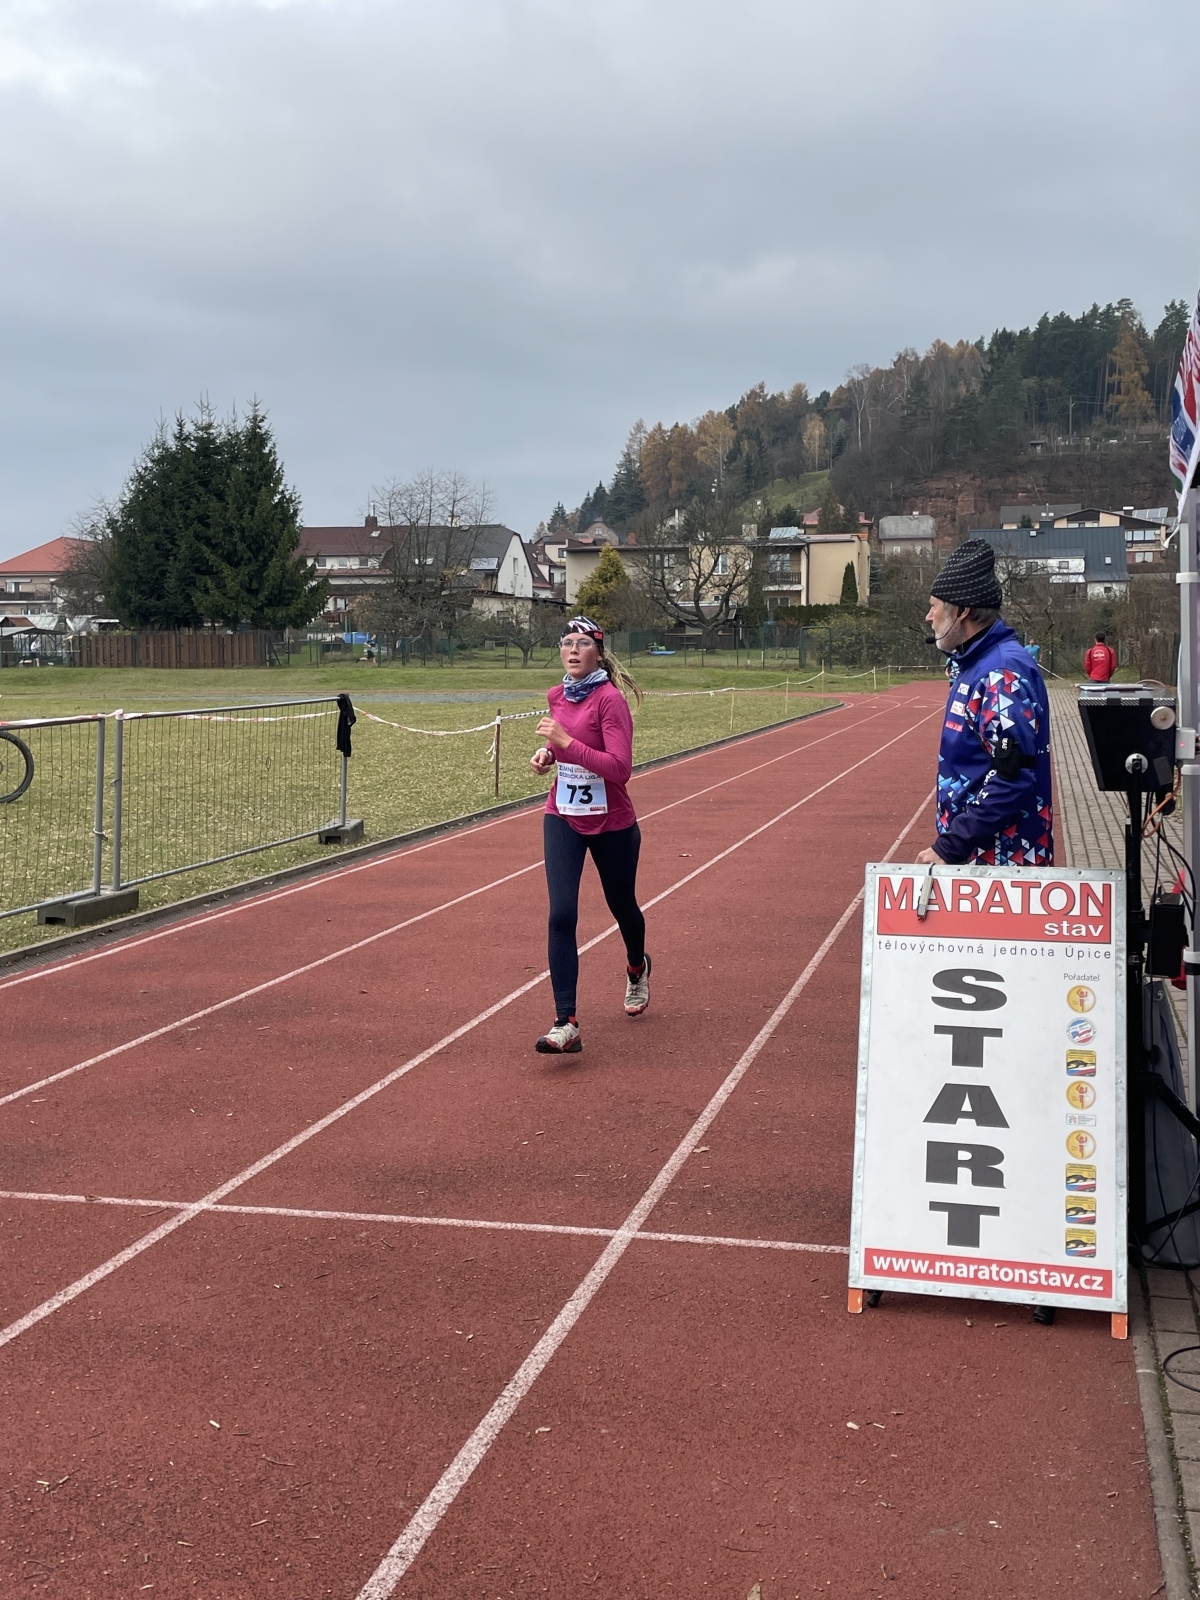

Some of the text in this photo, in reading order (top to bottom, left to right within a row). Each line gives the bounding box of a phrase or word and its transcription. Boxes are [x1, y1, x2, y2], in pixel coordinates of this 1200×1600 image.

[566, 784, 593, 804] 73
[878, 876, 1112, 917] MARATON
[1044, 920, 1104, 937] stav
[878, 940, 1112, 960] tělovýchovná jednota Úpice
[1063, 972, 1100, 982] Pořadatel
[922, 968, 1011, 1249] START
[872, 1255, 1104, 1291] www.maratonstav.cz
